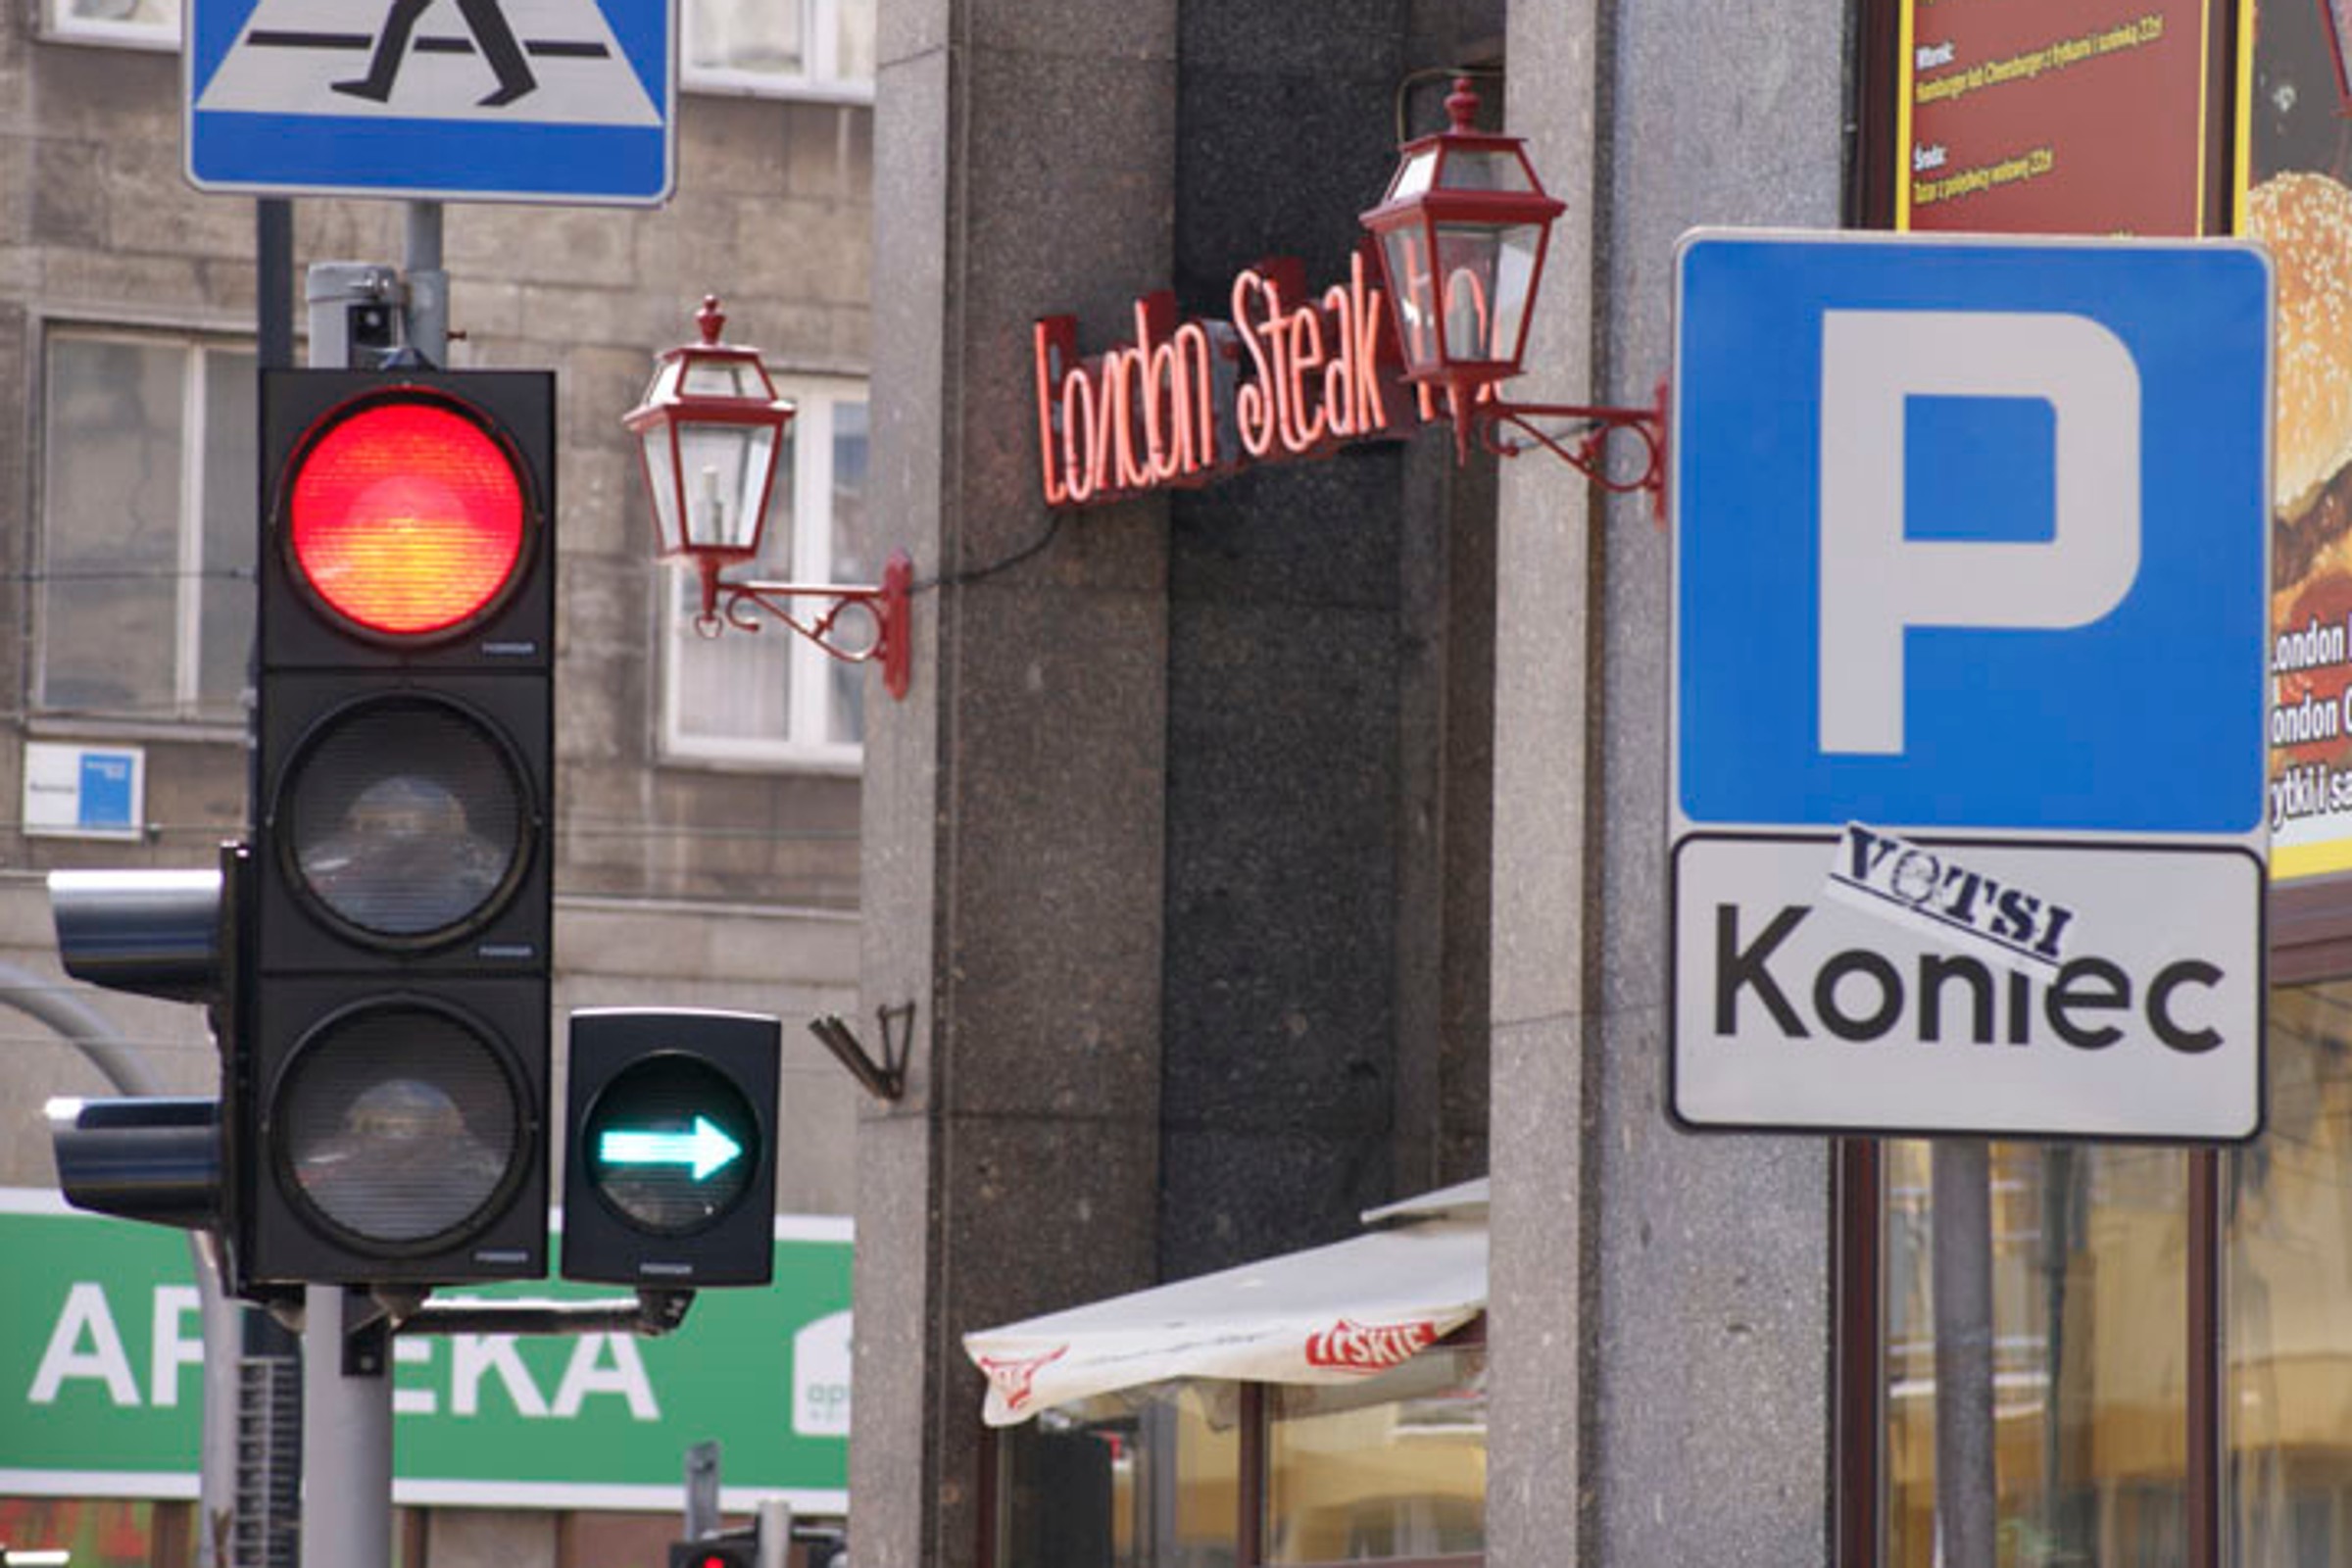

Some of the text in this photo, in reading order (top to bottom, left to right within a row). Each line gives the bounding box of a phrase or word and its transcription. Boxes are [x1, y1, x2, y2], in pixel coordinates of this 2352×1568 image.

[1035, 299, 1213, 503] London
[1232, 251, 1387, 457] Steak
[1819, 309, 2141, 755] P
[2272, 617, 2344, 671] ondon
[2273, 691, 2338, 744] ondon
[2272, 765, 2315, 827] ytki
[1715, 903, 2225, 1054] Koniec
[27, 1282, 662, 1420] APKA
